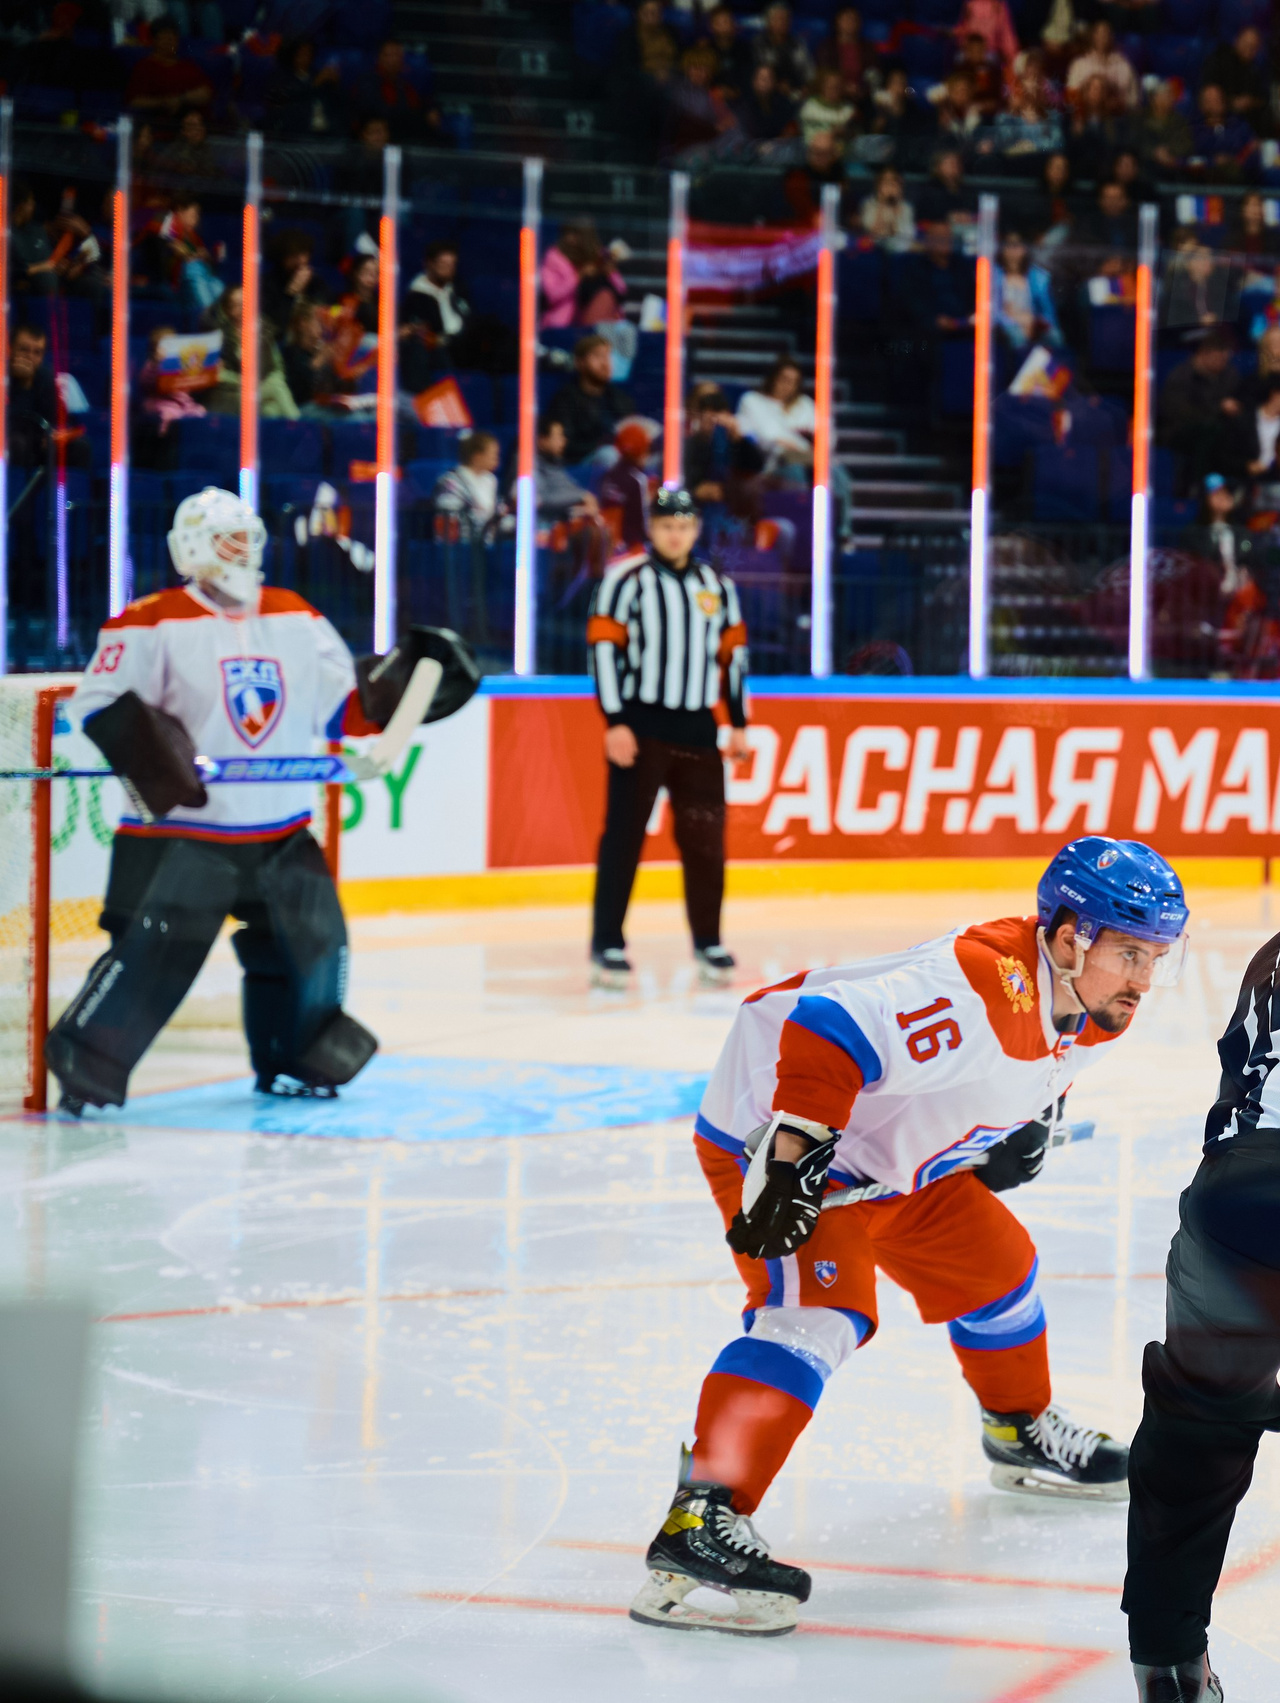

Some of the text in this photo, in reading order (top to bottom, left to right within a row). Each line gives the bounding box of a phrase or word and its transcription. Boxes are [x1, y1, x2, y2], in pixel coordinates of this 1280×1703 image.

[646, 725, 1123, 834] РАСНАЯ
[1060, 884, 1087, 904] CCM
[1159, 911, 1184, 921] CCM
[895, 996, 963, 1064] 16
